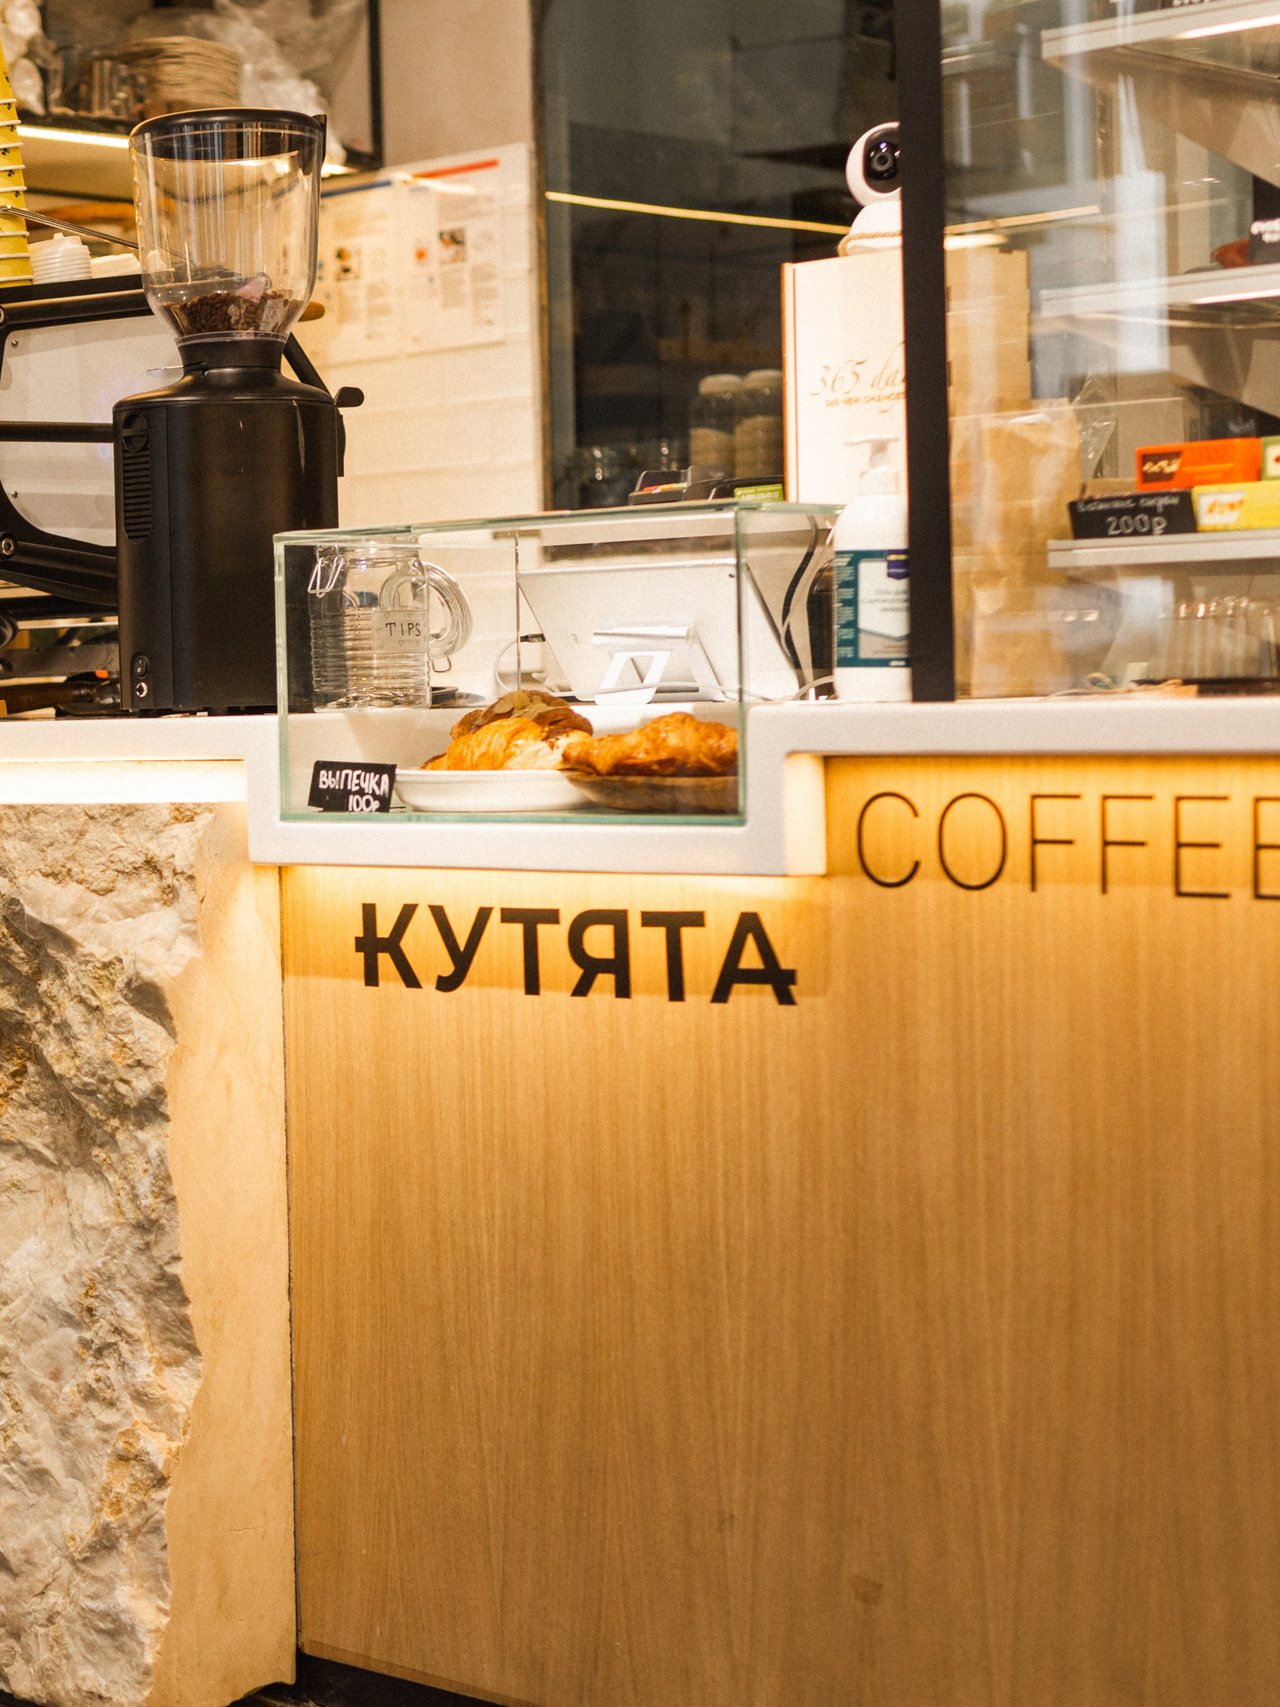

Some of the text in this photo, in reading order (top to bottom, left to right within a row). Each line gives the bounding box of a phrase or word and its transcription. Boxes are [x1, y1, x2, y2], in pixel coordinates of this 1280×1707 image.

[385, 622, 421, 637] TIPS
[318, 769, 389, 798] ВЫПЕЧКА
[355, 903, 797, 1006] КУТЯТА
